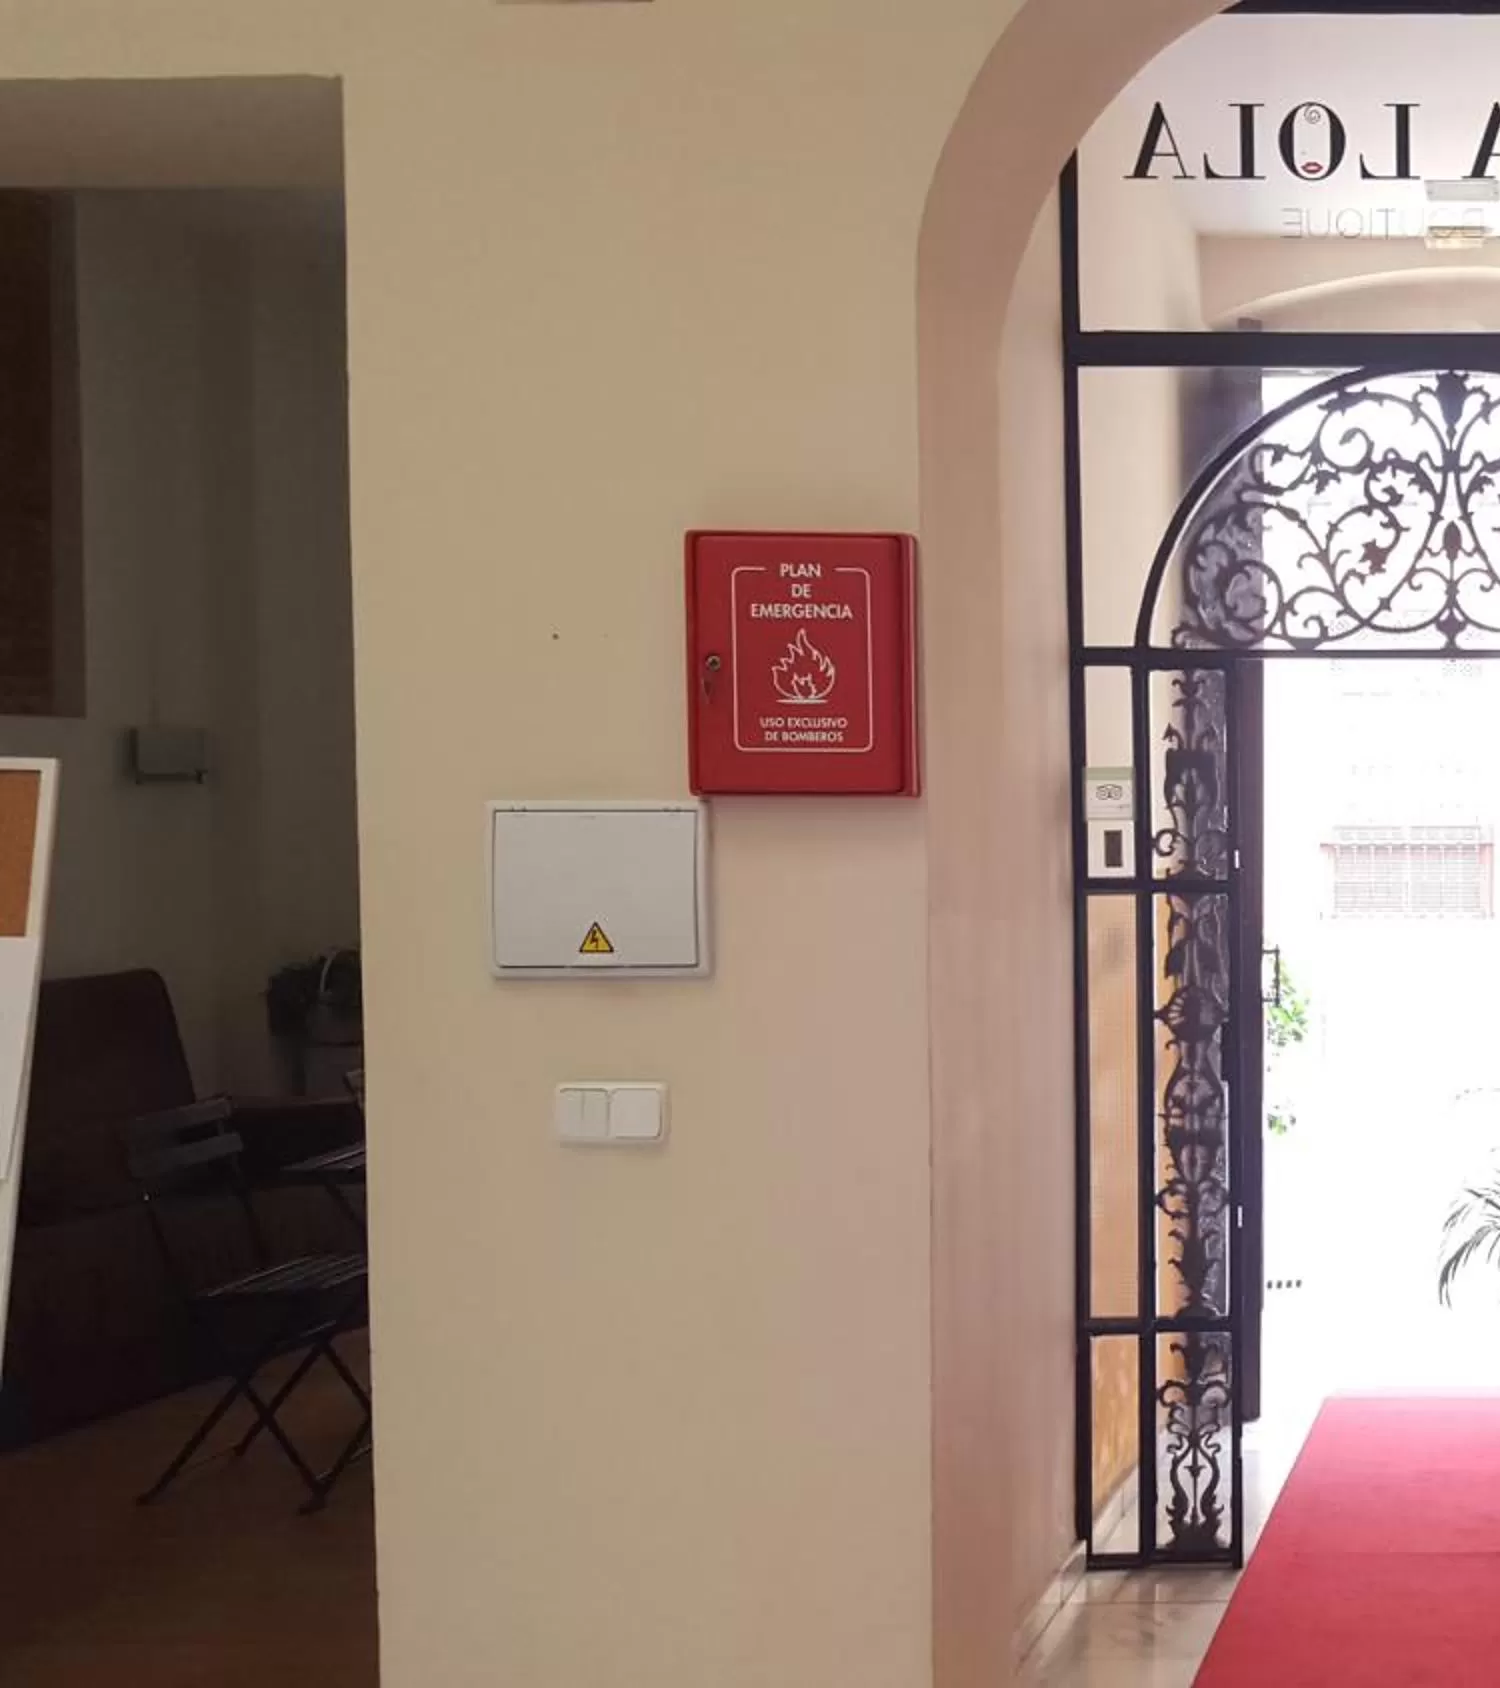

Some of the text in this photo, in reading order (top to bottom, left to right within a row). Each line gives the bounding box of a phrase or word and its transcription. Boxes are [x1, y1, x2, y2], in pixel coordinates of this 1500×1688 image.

[779, 563, 821, 578] PLAN
[791, 583, 812, 598] DE
[751, 603, 854, 619] EMERGENCIA
[760, 716, 848, 729] USO EXCLUSIVO
[764, 731, 844, 743] DE BOMBEROS
